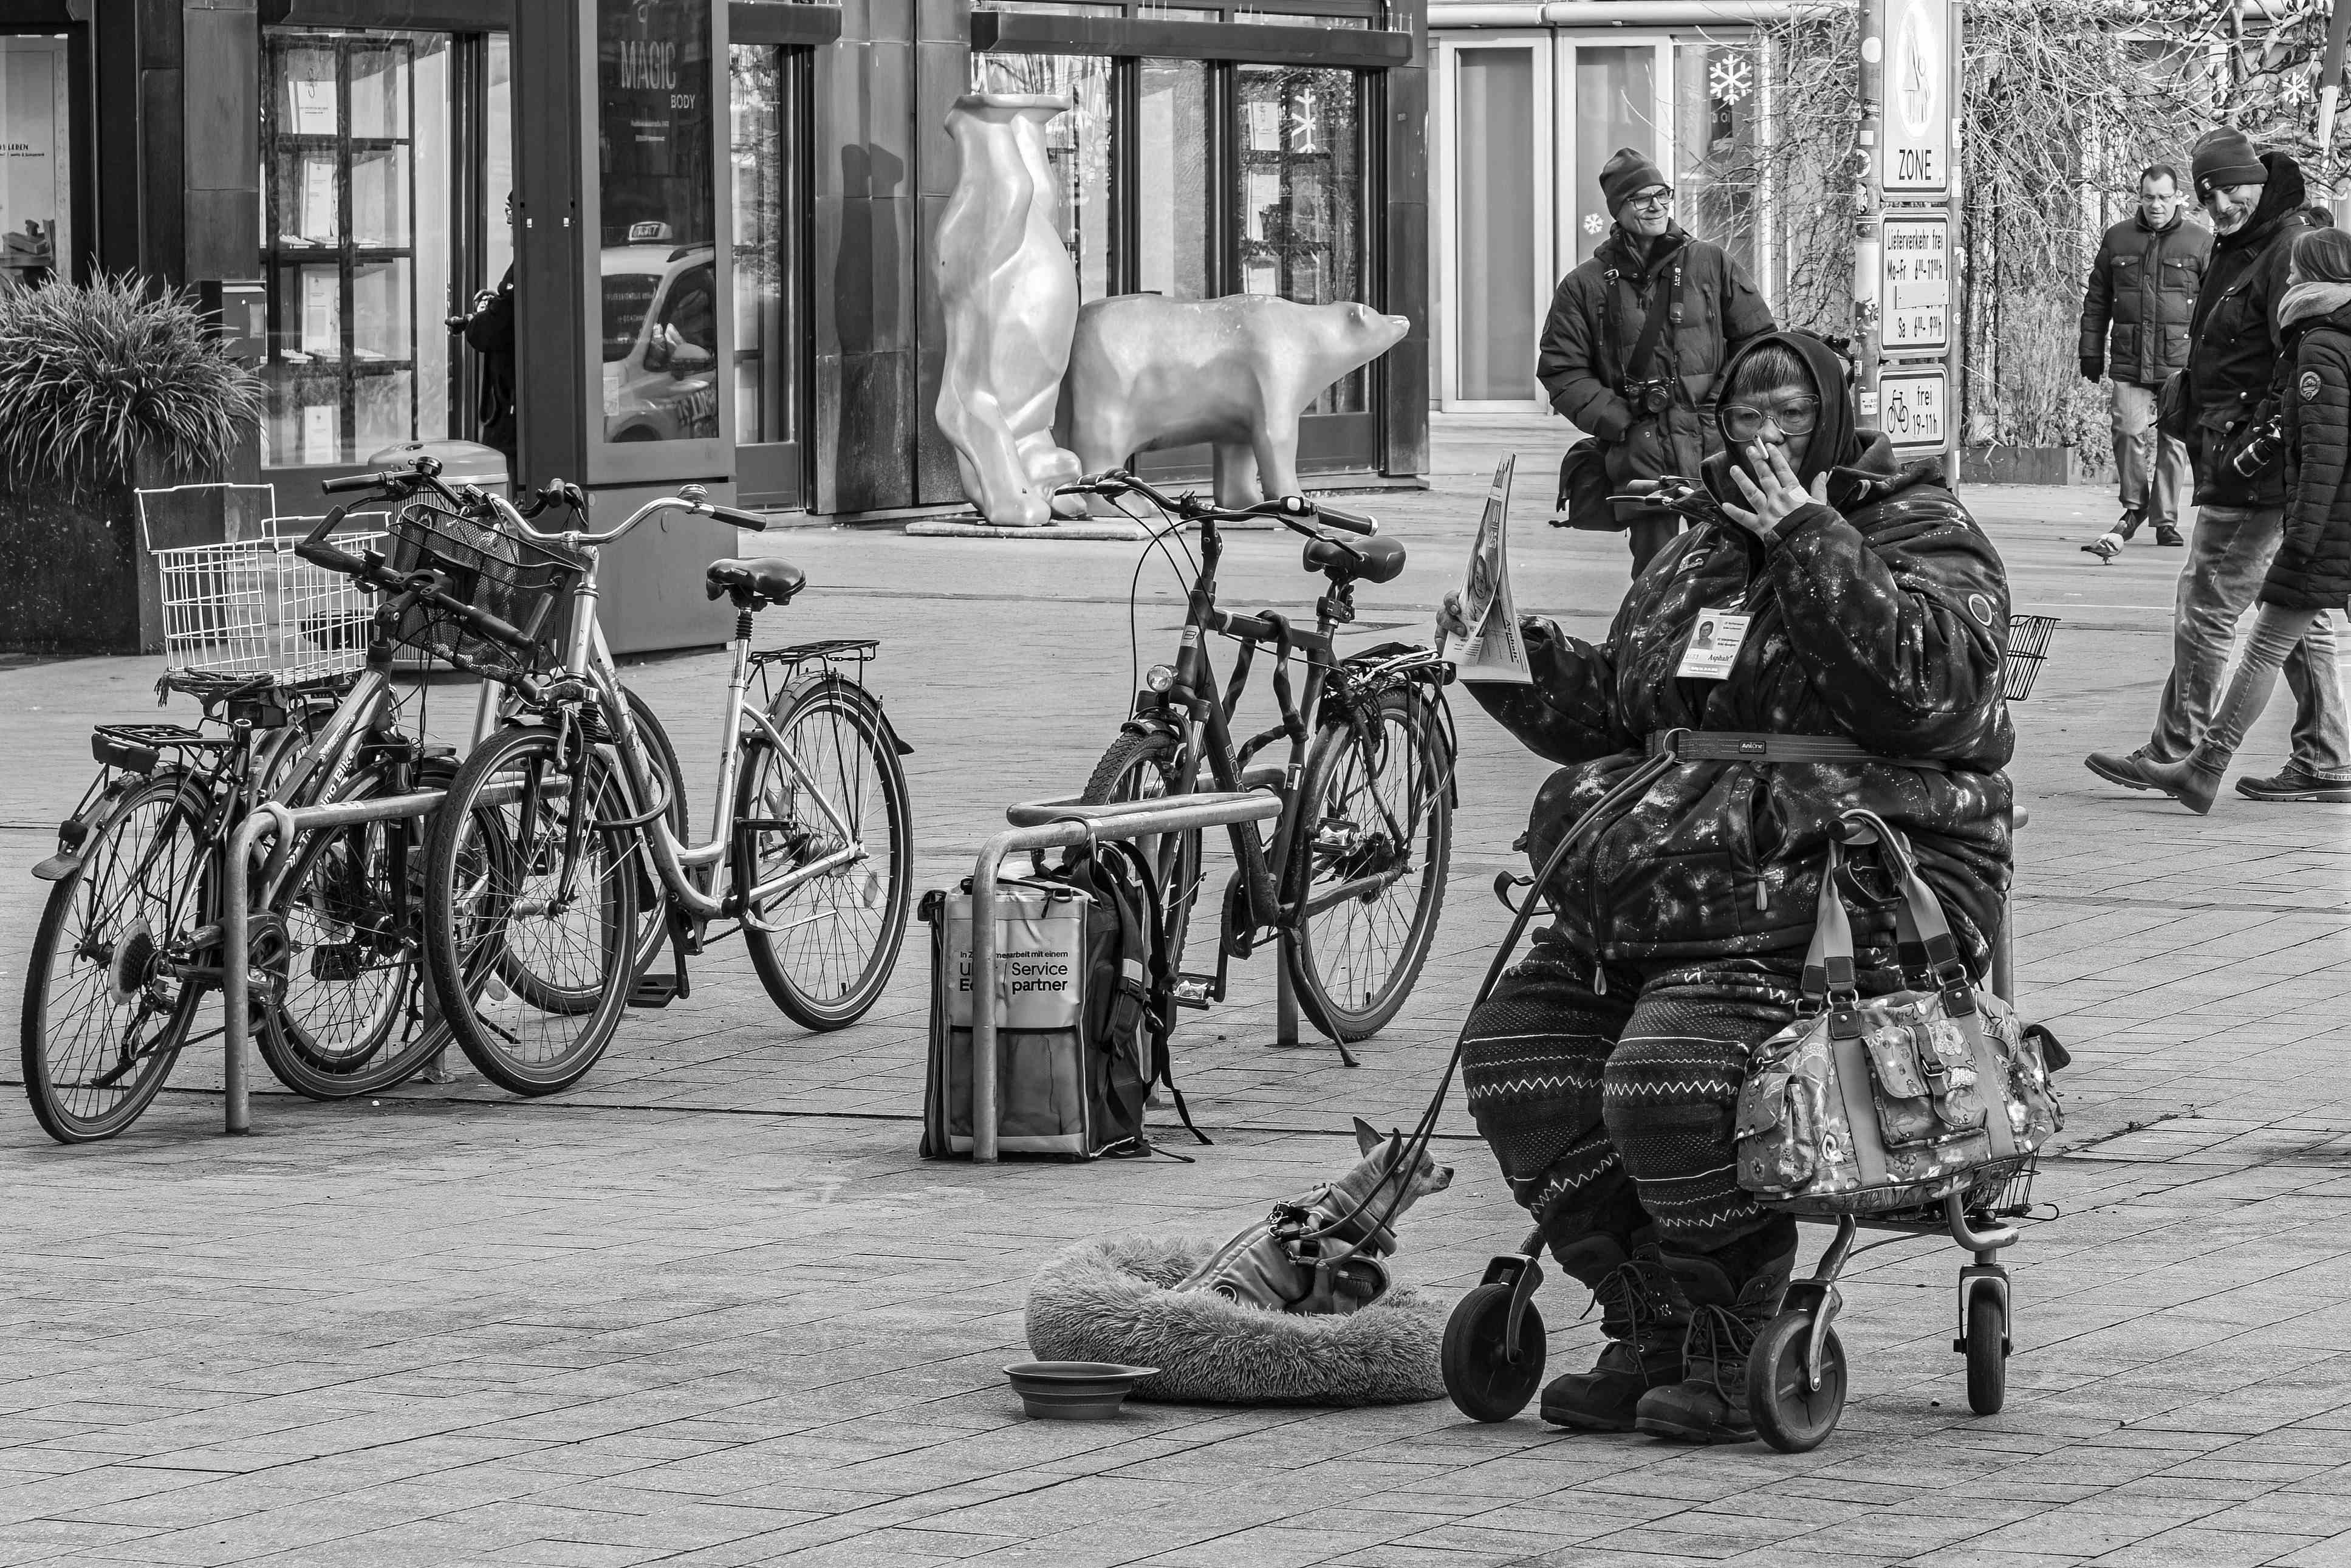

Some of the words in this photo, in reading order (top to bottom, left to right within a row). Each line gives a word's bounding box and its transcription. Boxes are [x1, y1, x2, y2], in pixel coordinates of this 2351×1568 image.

[620, 41, 676, 89] MAGIC
[671, 94, 695, 109] BODY
[1899, 149, 1931, 180] ZONE
[1887, 228, 1929, 250] Lieferverkehr
[1932, 228, 1943, 250] frei
[1887, 259, 1906, 280] Mo-Fr
[1898, 317, 1905, 338] Sa
[1917, 385, 1932, 406] frei
[1912, 413, 1937, 435] 19-11h
[1012, 962, 1068, 976] Service
[1011, 978, 1068, 995] partner
